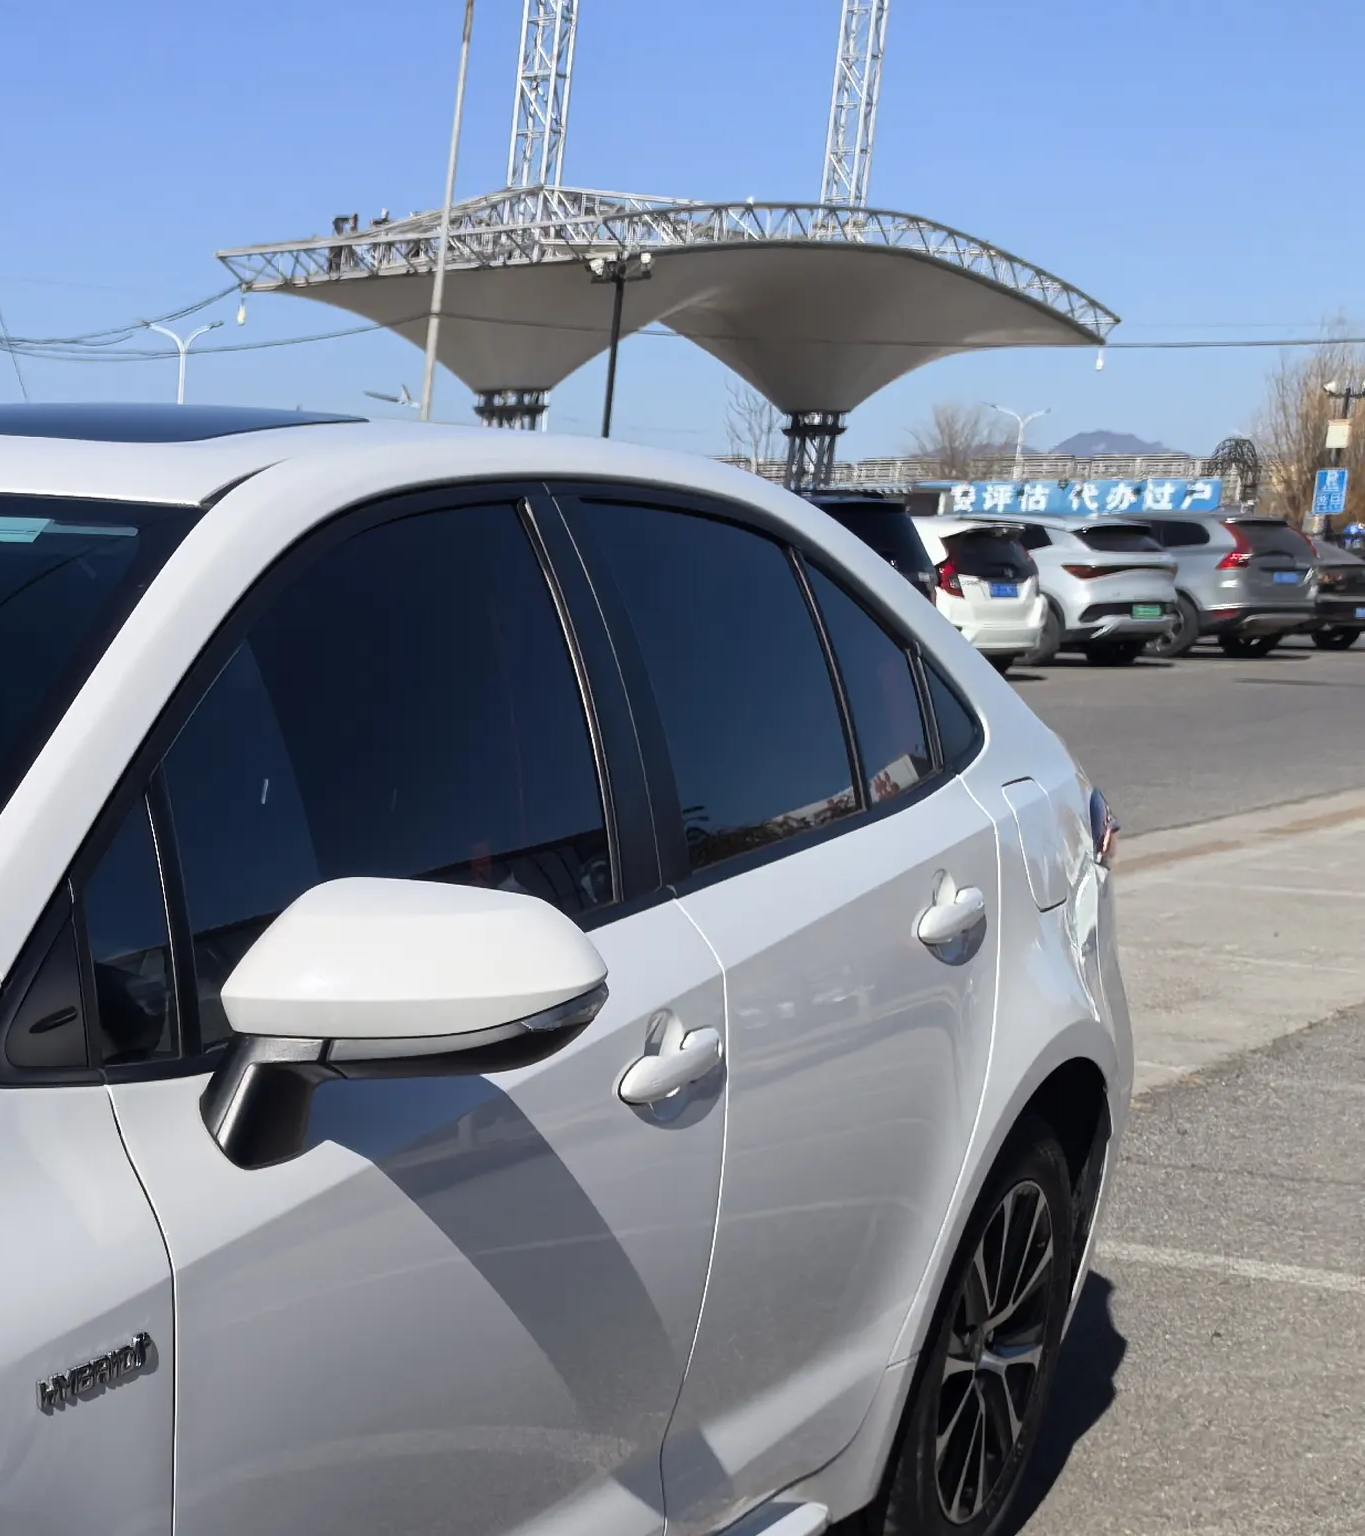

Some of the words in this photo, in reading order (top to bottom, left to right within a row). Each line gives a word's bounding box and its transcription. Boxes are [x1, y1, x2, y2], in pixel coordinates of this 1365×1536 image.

[1070, 481, 1213, 512] 代办过户
[36, 1332, 152, 1410] HYBRID
